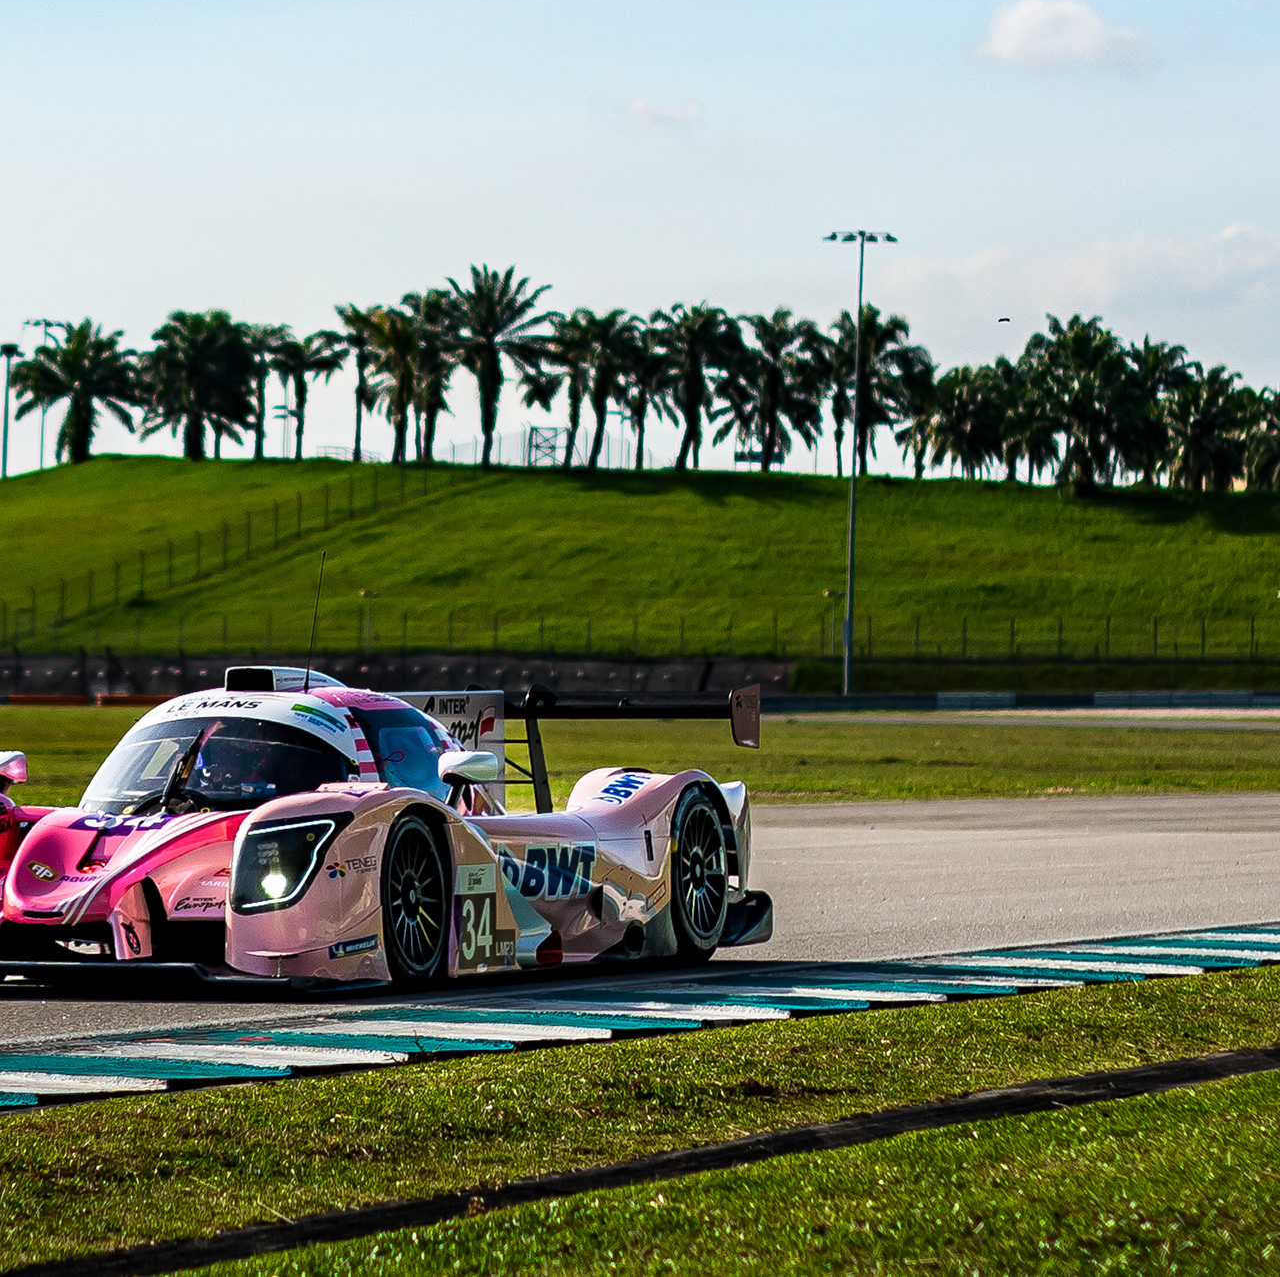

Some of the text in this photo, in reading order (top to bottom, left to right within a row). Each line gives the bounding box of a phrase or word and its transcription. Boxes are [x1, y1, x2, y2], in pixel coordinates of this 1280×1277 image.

[166, 700, 263, 714] LE MANS
[601, 774, 653, 800] BWT
[31, 864, 54, 878] AP
[519, 845, 597, 898] BWT
[462, 897, 493, 961] 34
